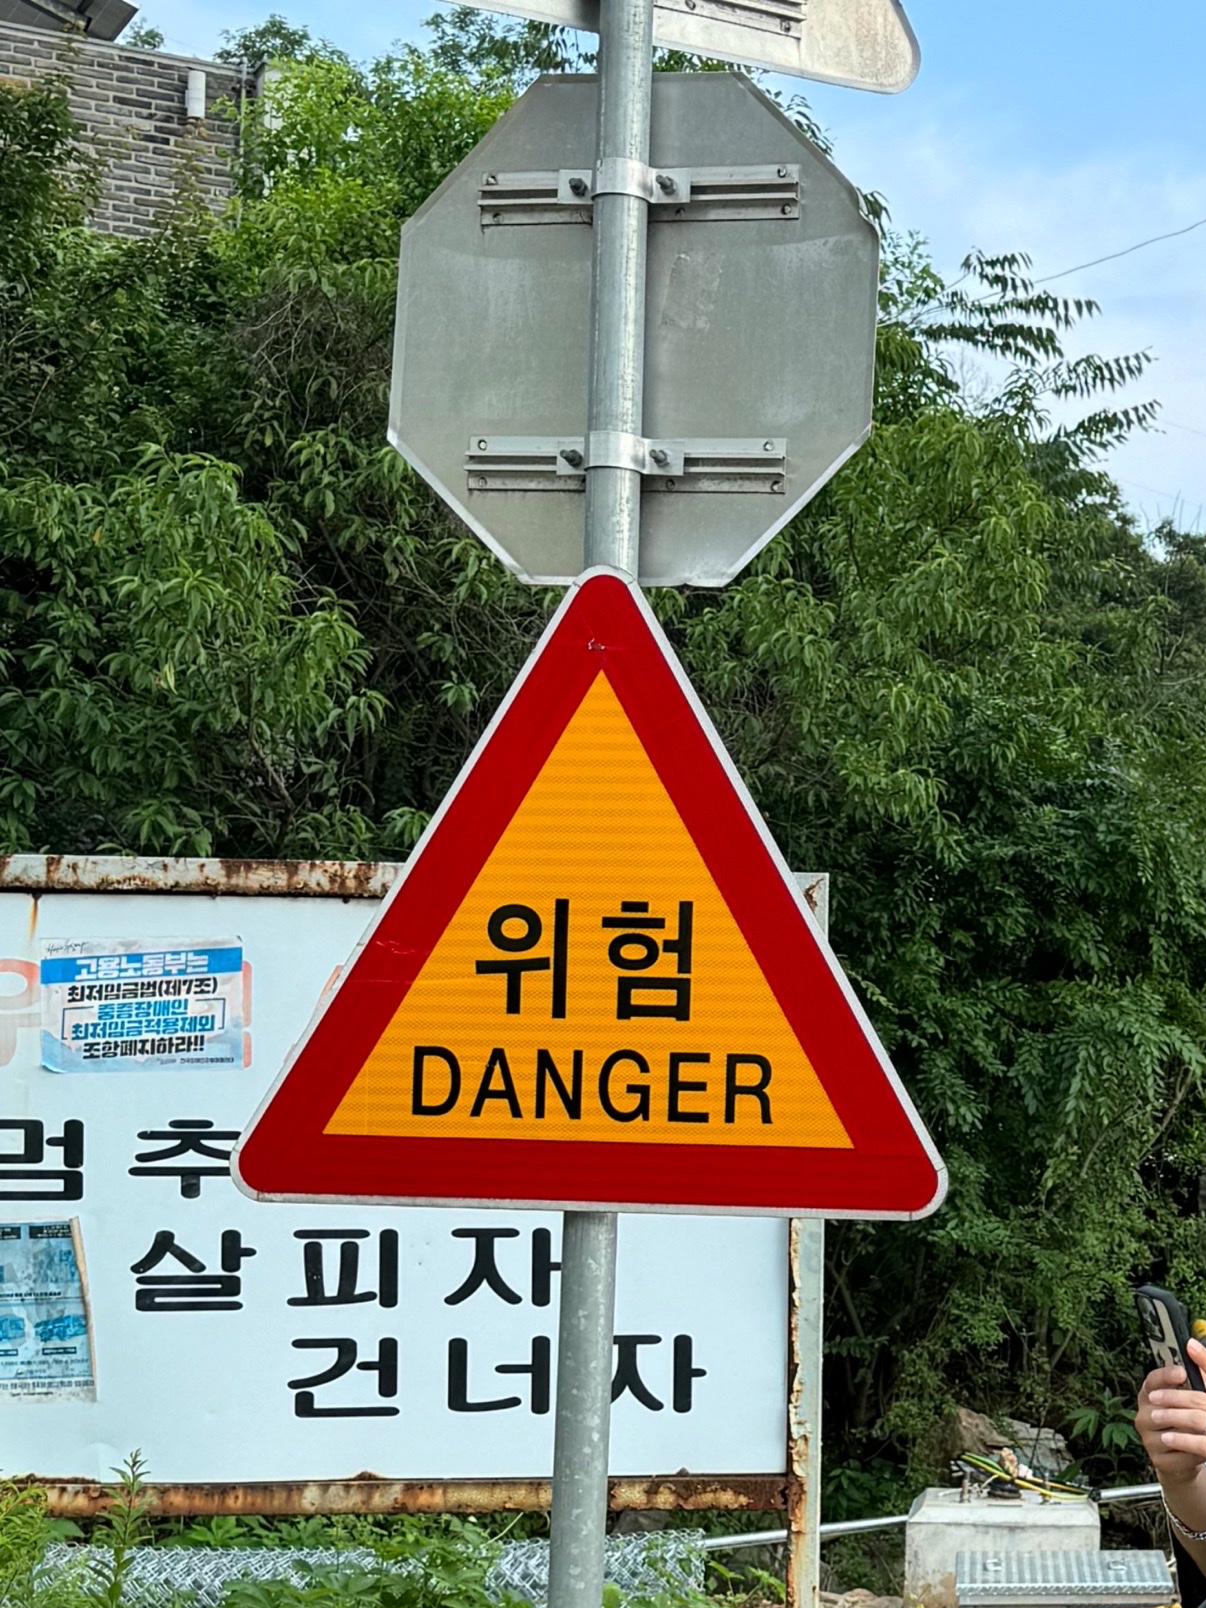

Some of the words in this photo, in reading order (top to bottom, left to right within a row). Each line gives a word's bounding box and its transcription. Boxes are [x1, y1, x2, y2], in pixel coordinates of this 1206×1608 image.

[74, 951, 209, 981] 고용노동부는
[475, 898, 694, 1022] 위험
[67, 977, 218, 1003] 최저임금법(제7조)
[71, 1015, 215, 1041] 최저임금적용제외
[411, 1045, 773, 1125] DANGER
